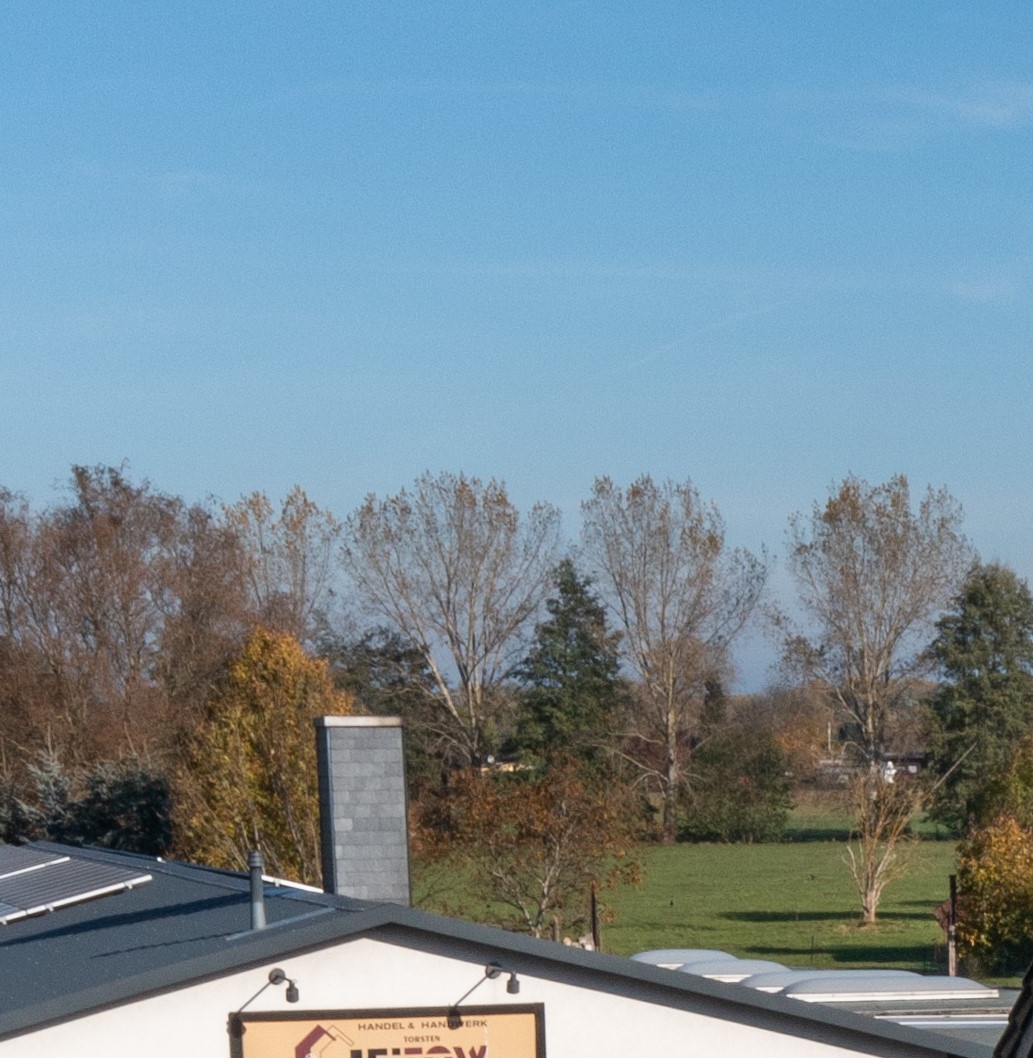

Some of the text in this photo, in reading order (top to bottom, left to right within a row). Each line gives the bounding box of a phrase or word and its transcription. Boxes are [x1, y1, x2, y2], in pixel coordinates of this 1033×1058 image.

[357, 1019, 488, 1031] HANDEL & HANERK
[403, 1034, 441, 1044] TORSTEN
